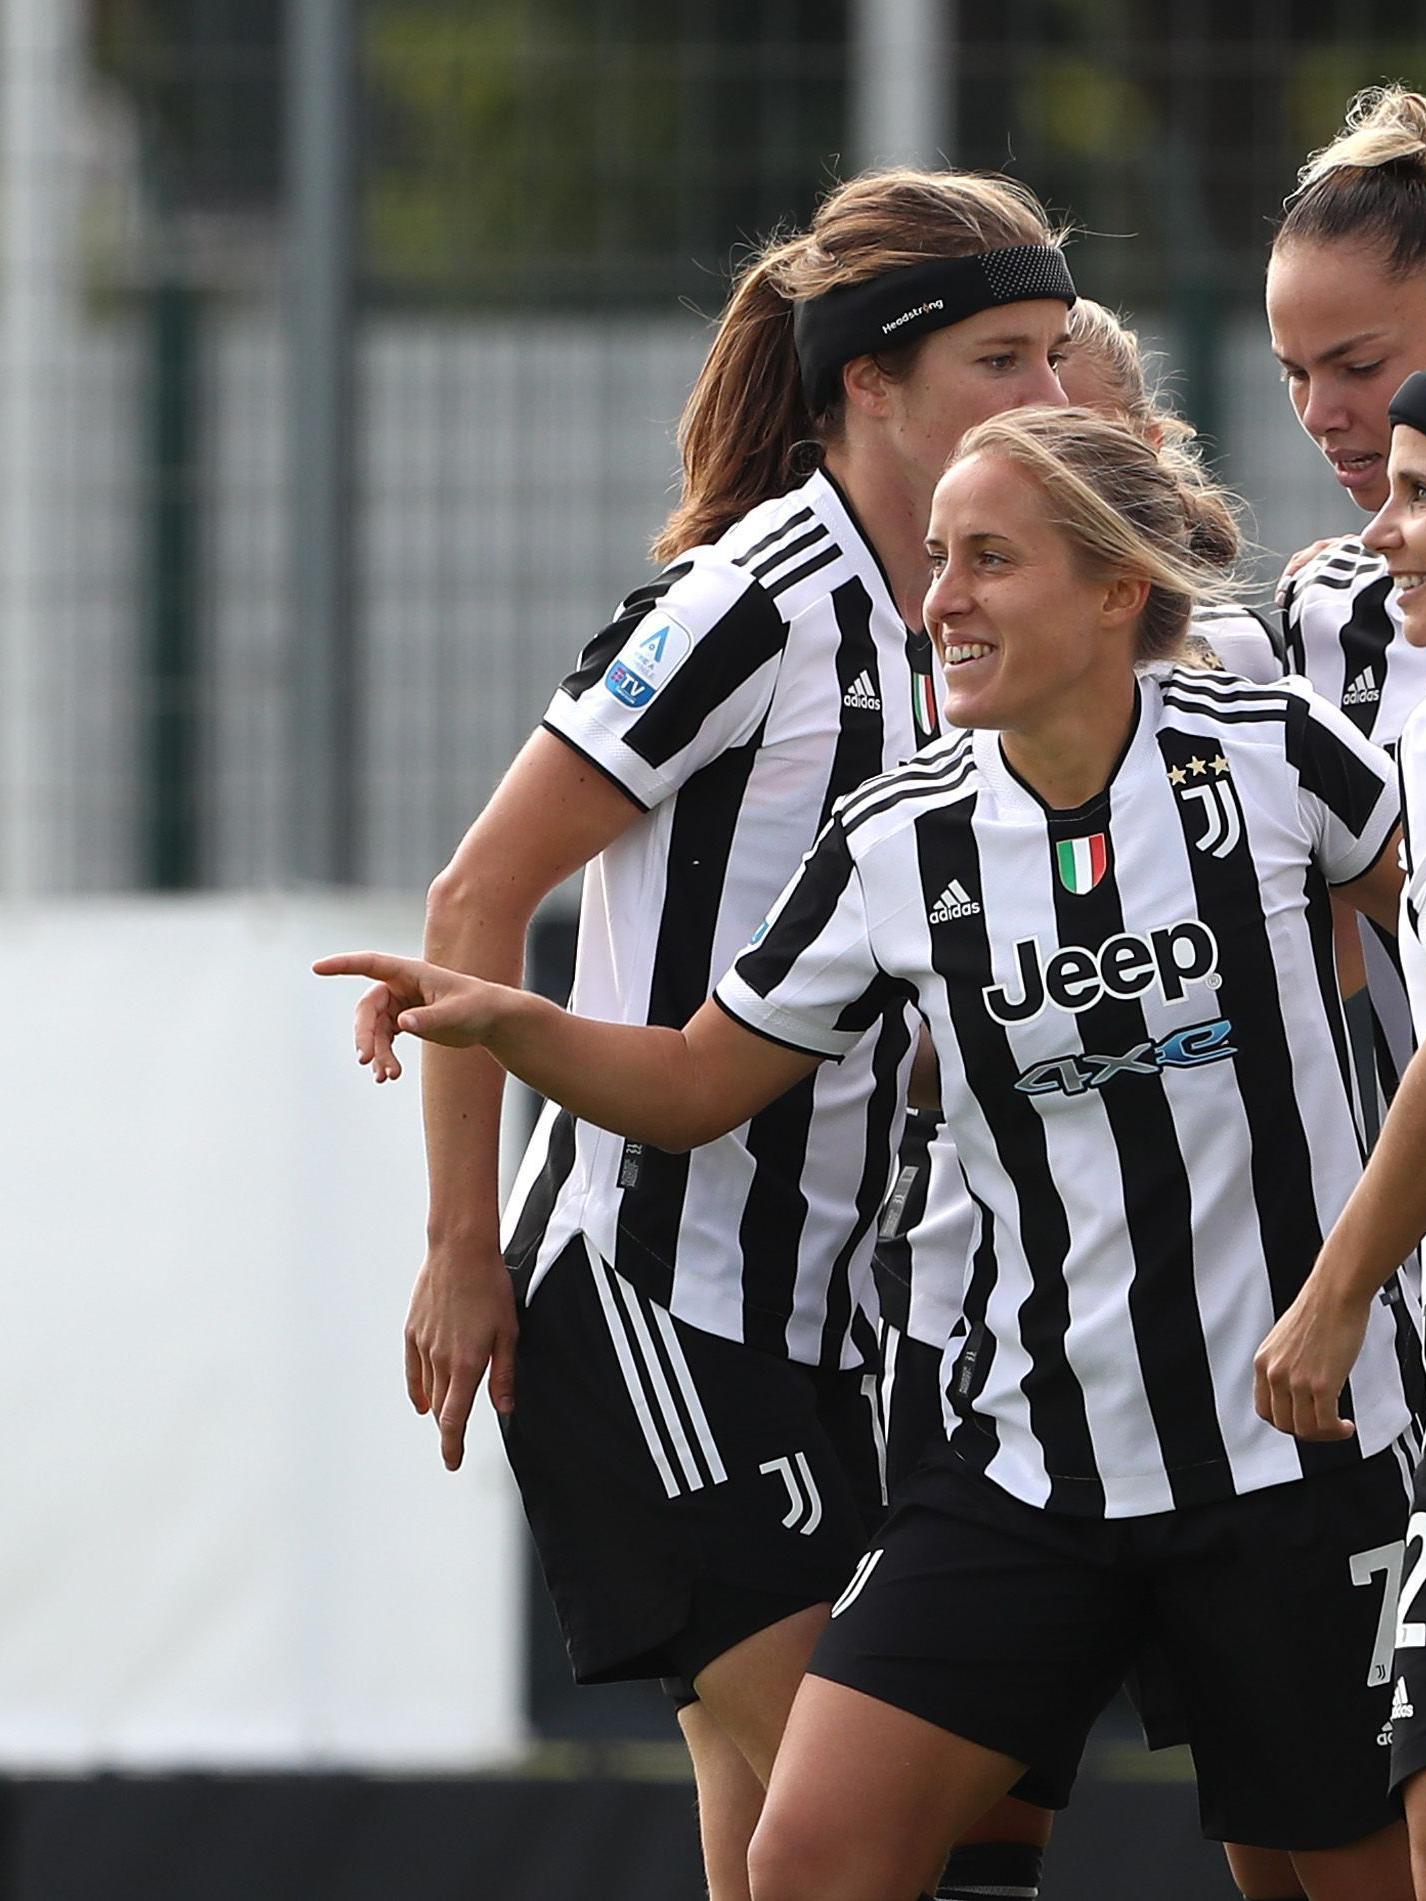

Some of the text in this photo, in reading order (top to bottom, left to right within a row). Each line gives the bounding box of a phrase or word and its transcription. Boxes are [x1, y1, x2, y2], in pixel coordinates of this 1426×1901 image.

[843, 694, 881, 711] adidas
[929, 902, 981, 924] adidas
[982, 919, 1219, 1026] Jeep
[1349, 1539, 1406, 1687] 7
